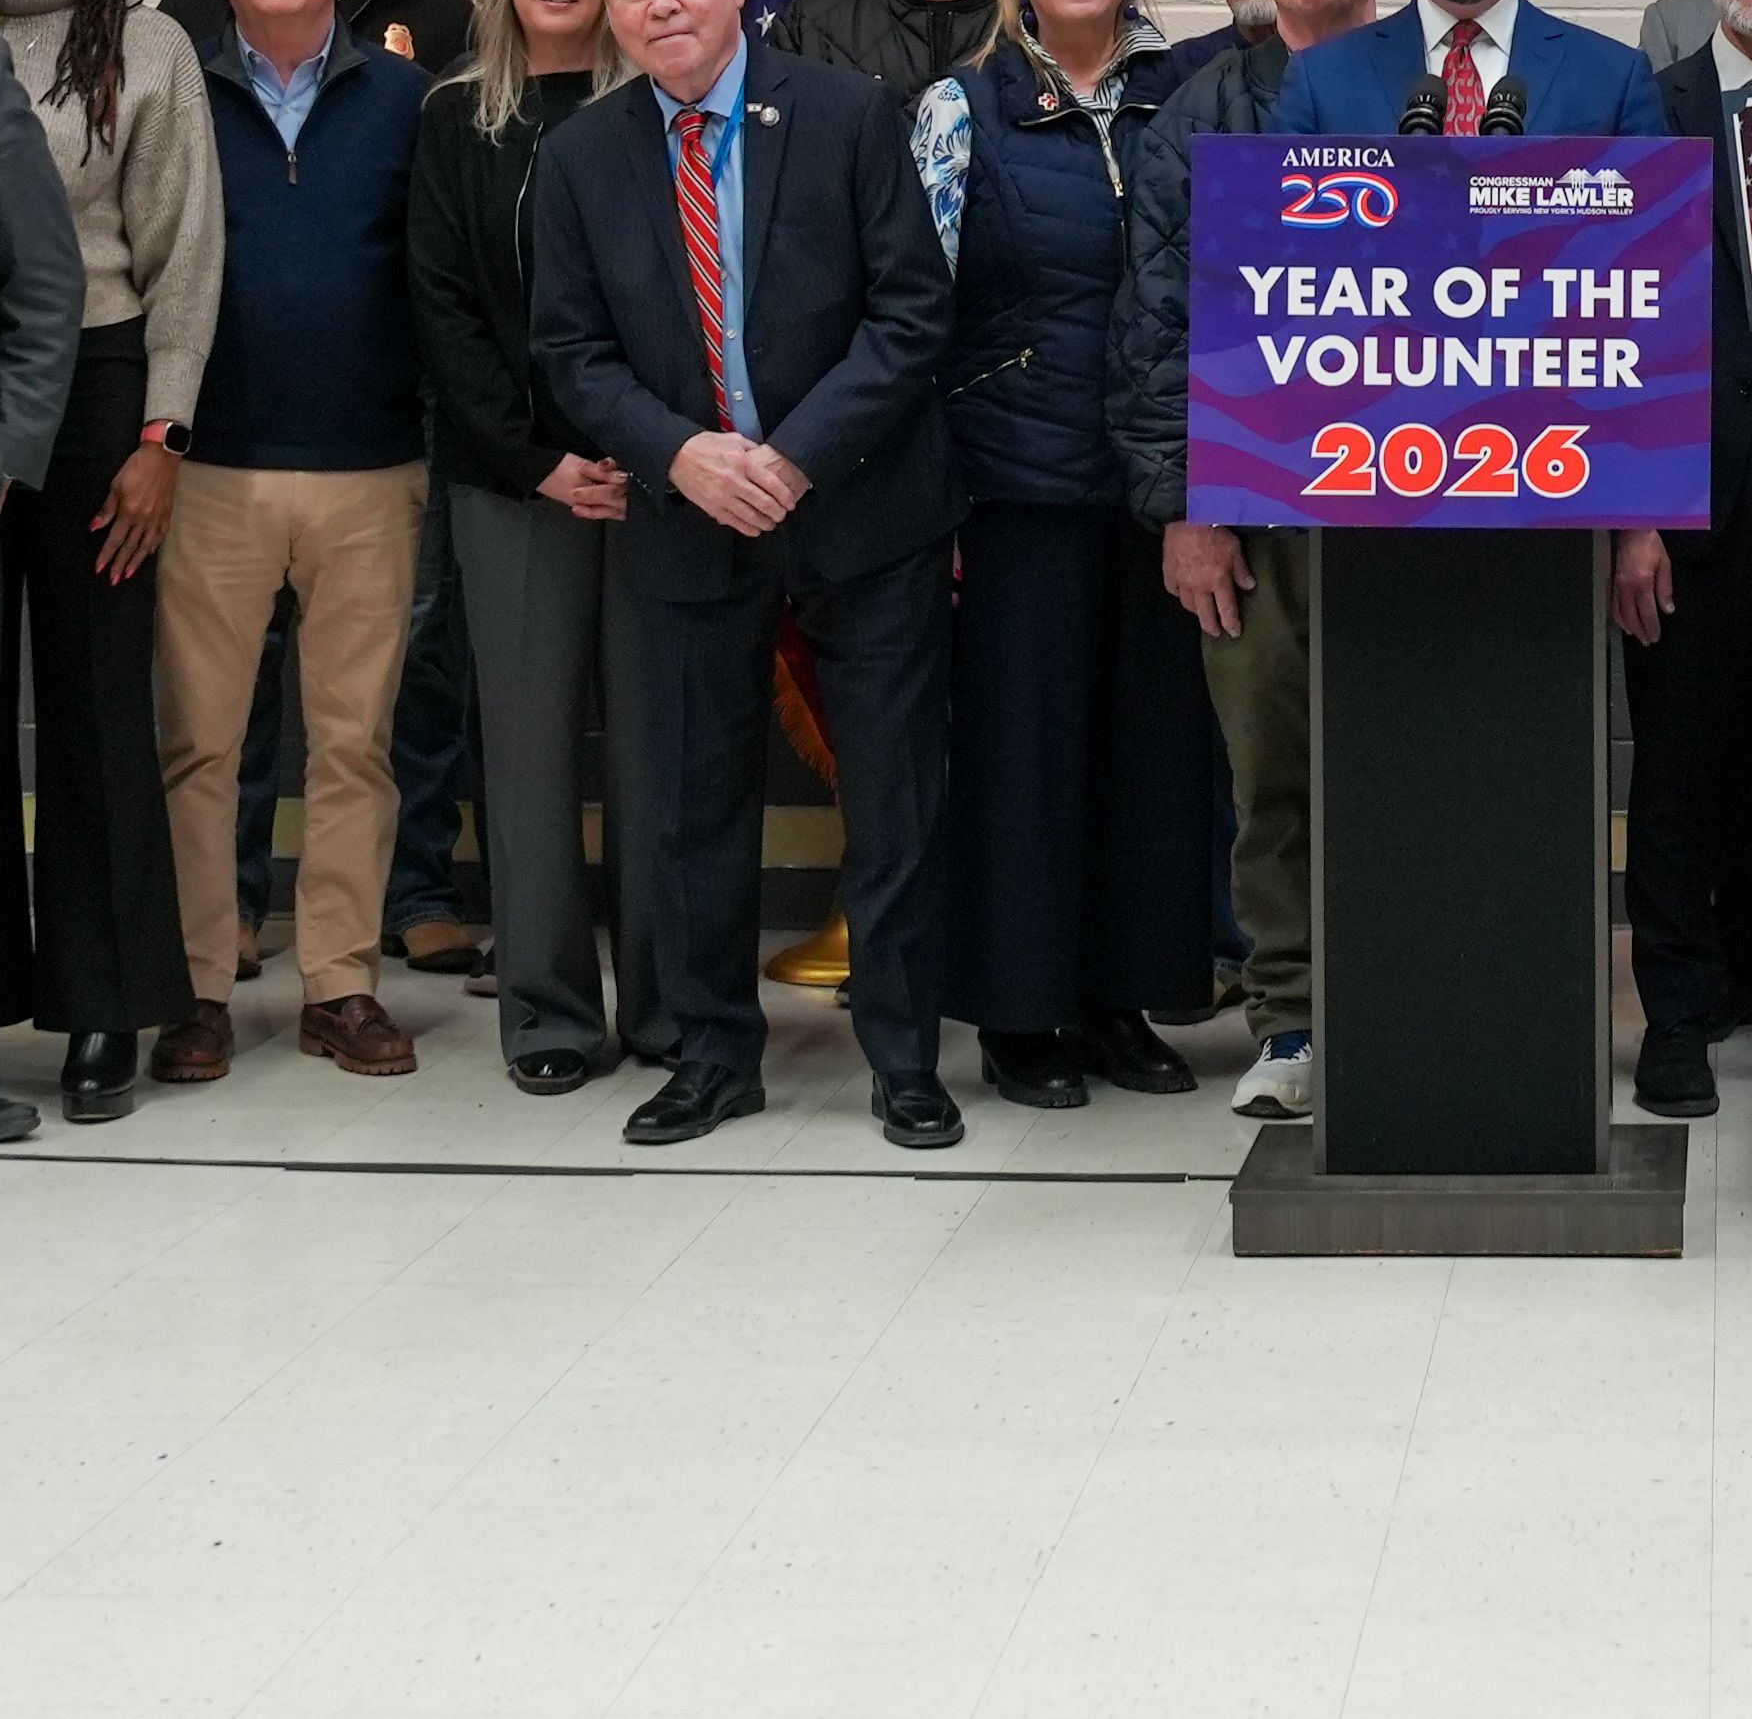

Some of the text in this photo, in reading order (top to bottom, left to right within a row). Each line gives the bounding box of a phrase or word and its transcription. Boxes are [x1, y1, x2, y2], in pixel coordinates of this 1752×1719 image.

[1282, 147, 1395, 167] AMERICA
[1470, 177, 1553, 187] CONGRESSMAN
[1470, 188, 1634, 207] MIKE LAWLER
[1238, 266, 1660, 319] YEAR OF THE
[1256, 335, 1643, 388] VOLUNTEER
[1300, 422, 1591, 499] 2026
